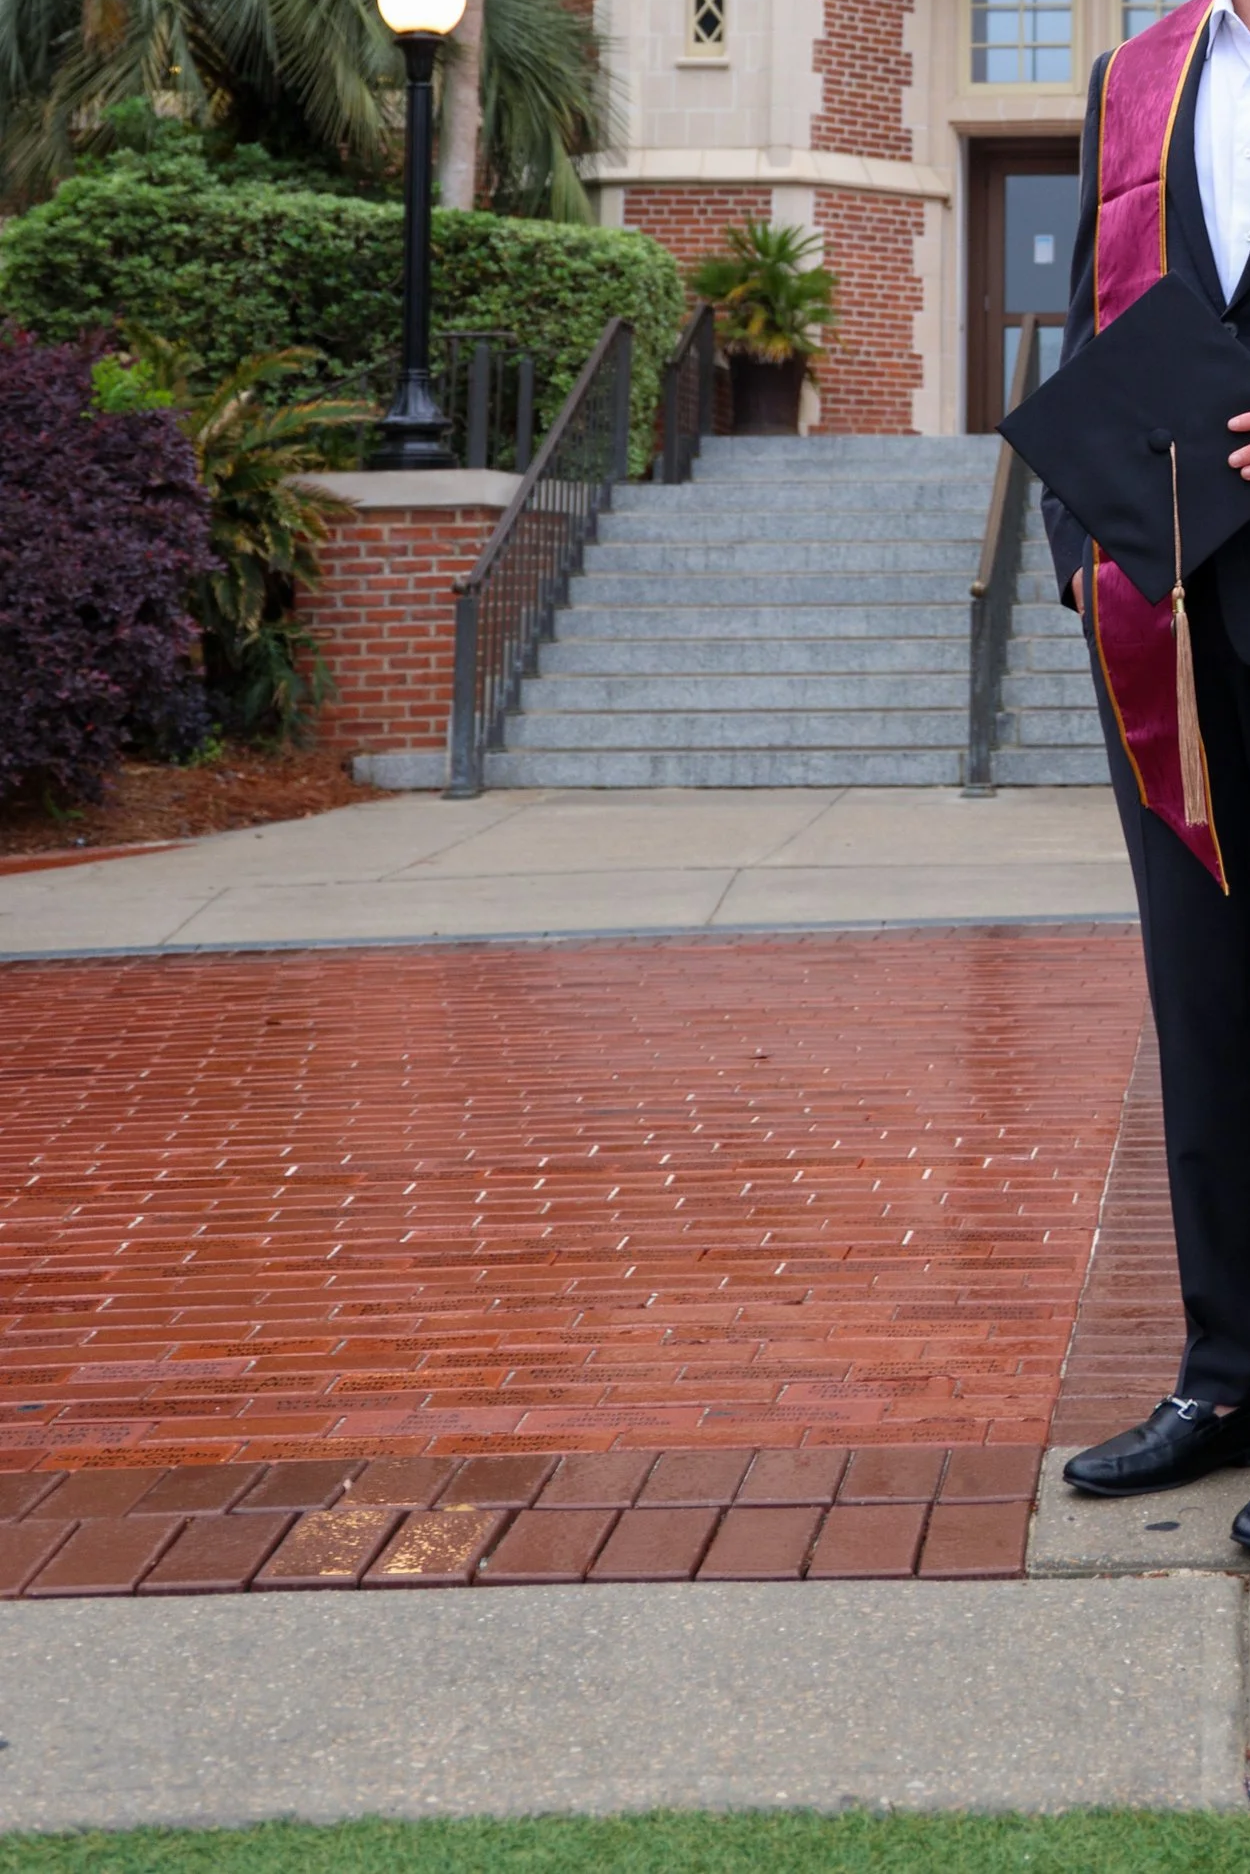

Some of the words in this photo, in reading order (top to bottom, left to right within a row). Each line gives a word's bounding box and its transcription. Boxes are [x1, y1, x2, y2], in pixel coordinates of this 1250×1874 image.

[101, 1446, 188, 1454] Miranda
[54, 1454, 130, 1462] Stalvey
[142, 1452, 222, 1460] Combs
